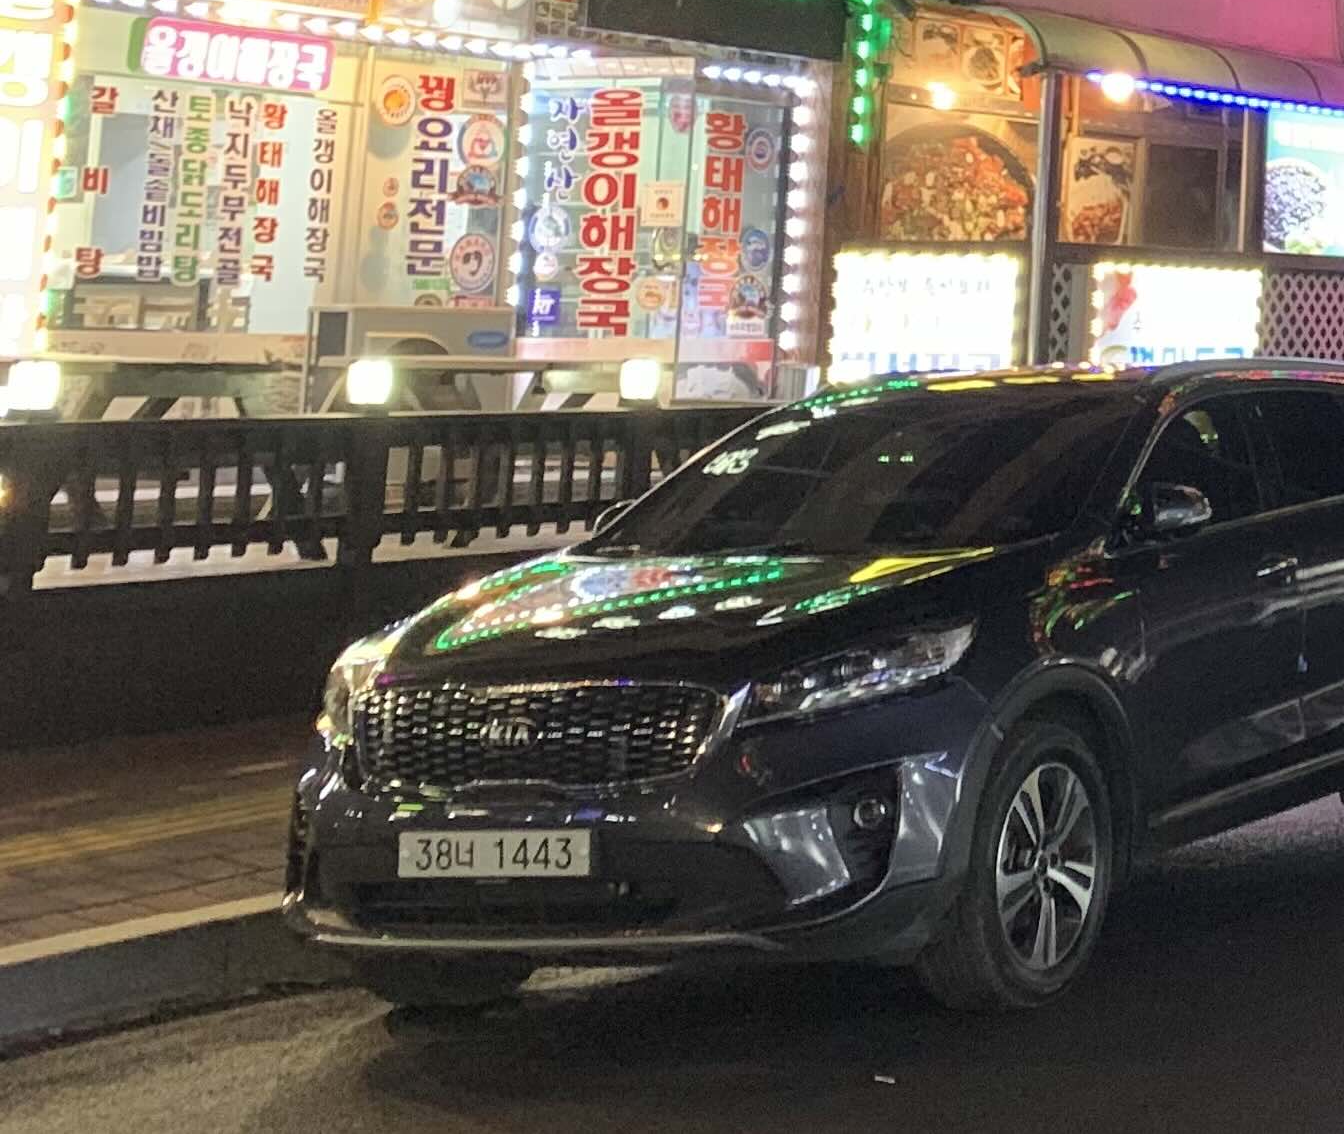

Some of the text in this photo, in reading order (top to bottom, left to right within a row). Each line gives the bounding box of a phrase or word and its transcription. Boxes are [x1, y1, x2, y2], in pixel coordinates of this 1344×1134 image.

[143, 24, 330, 90] 올갱이해장국
[75, 86, 120, 277] 갈비탕
[172, 94, 212, 282] 토종닭도리탕
[215, 100, 253, 286] 낙지두부전골
[250, 102, 289, 282] 황태해장국
[303, 107, 339, 283] 올갱이해장국
[577, 89, 643, 336] 올갱이해장국
[698, 112, 747, 309] 황태해장국
[494, 836, 572, 870] 1443
